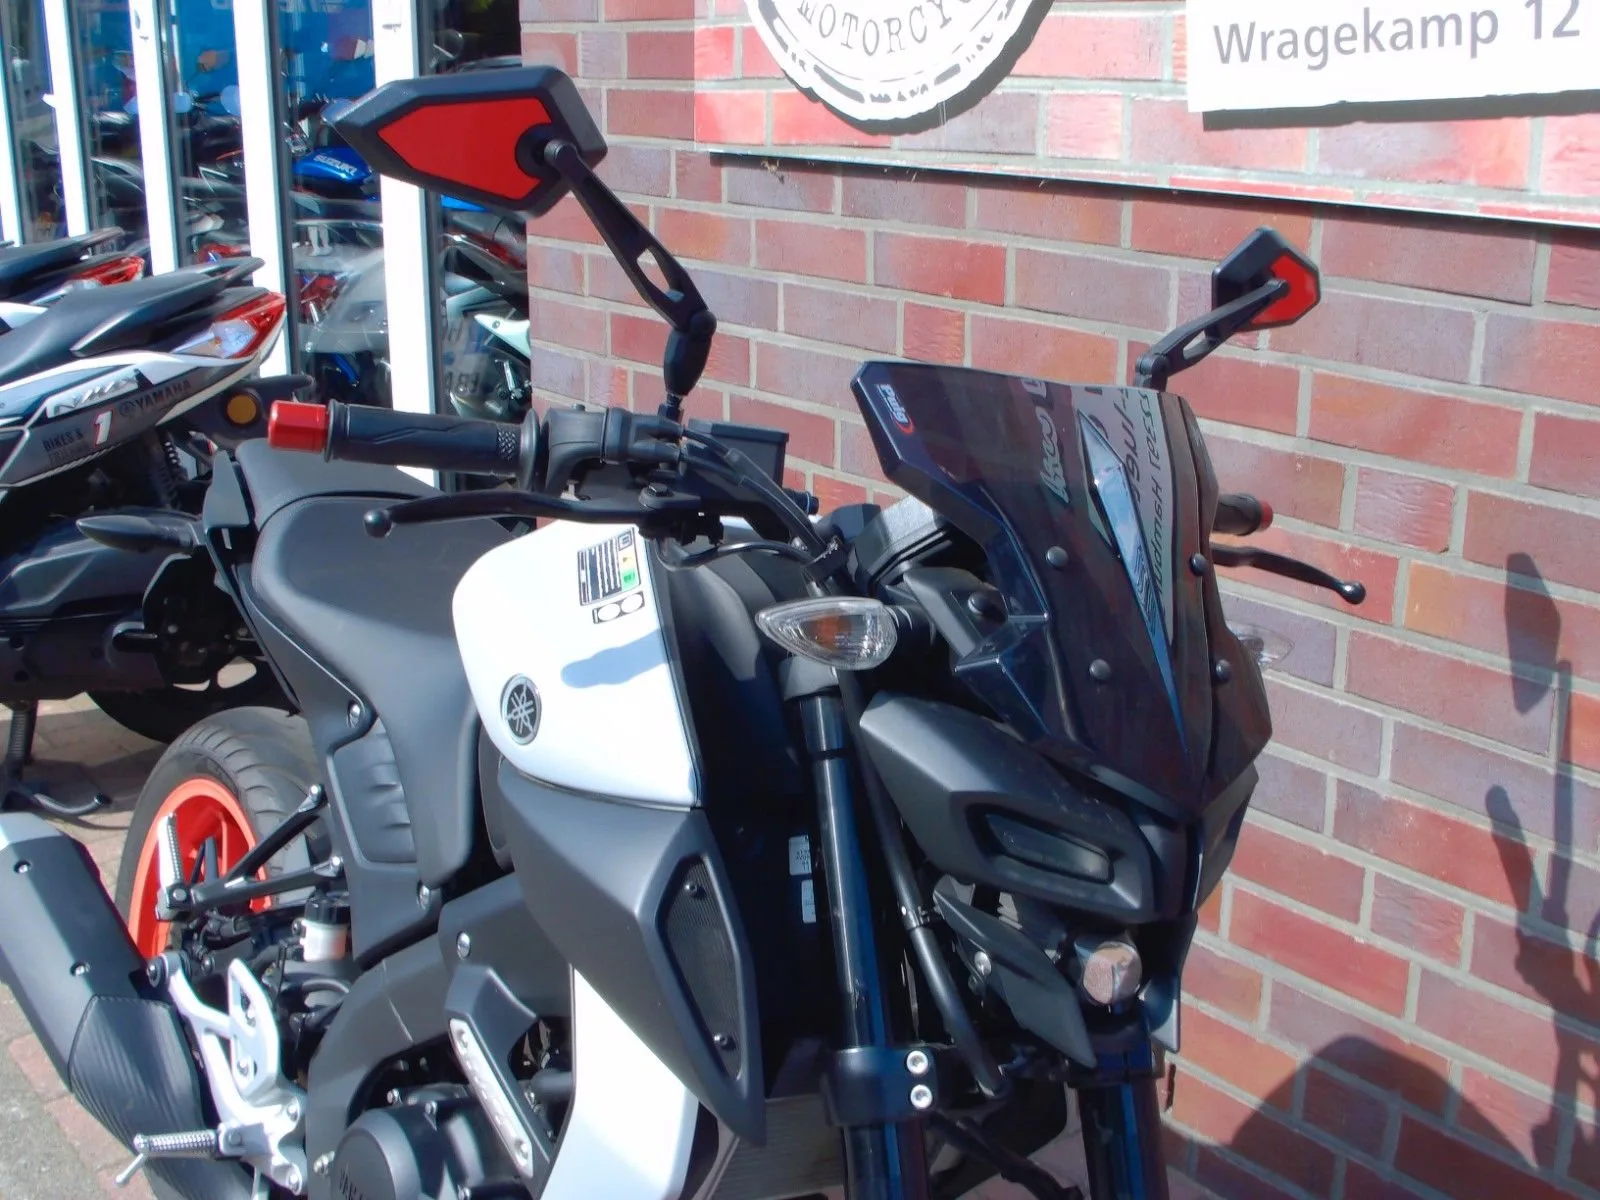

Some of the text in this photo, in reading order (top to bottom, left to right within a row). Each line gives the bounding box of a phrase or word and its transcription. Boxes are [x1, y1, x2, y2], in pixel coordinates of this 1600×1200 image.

[797, 0, 971, 56] MOTORCY
[1213, 0, 1581, 71] Wragekamp 12
[136, 379, 192, 410] YAMAHA
